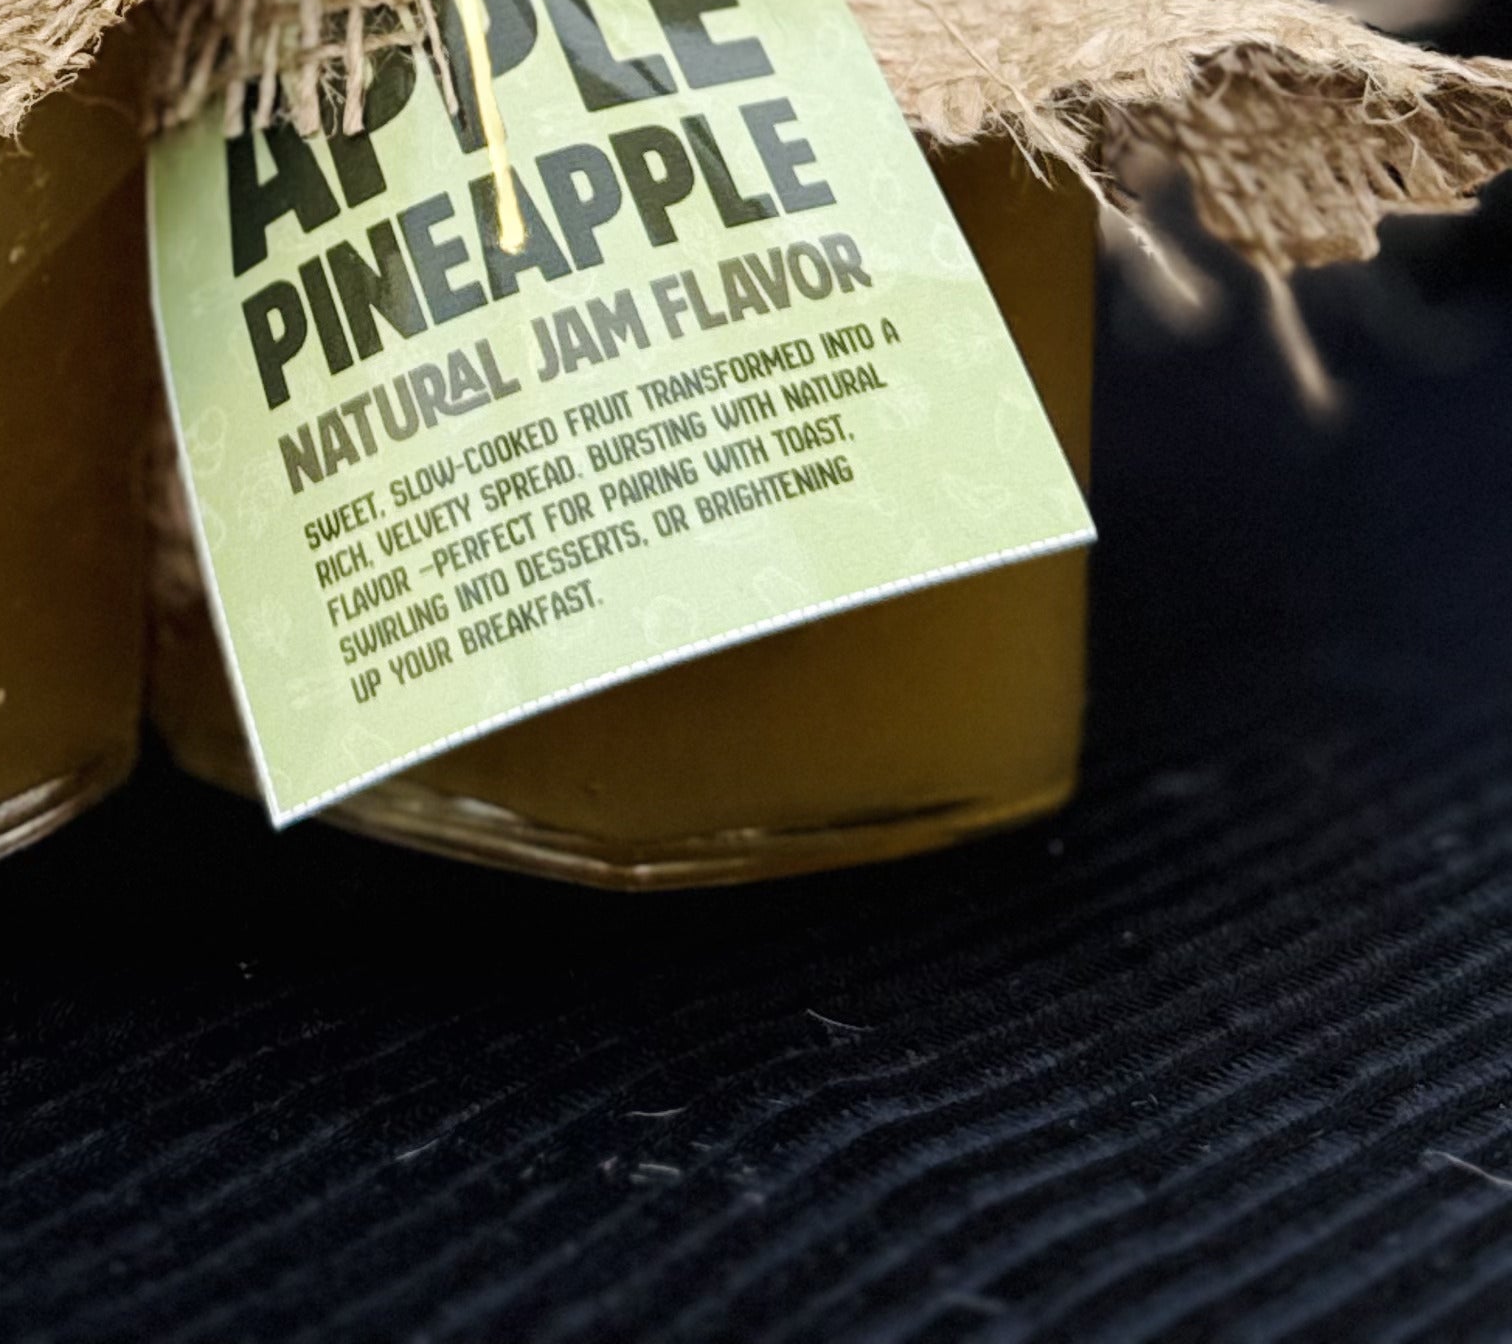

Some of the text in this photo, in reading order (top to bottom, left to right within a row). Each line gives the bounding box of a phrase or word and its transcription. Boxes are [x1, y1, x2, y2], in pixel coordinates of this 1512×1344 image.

[240, 99, 837, 412] PINEAPPLE
[277, 234, 873, 496] NATURAL JAM FLAVOR
[303, 317, 901, 551] SWEET, SLOW-COOKED FRUIT TRANSFORMED INTO A
[314, 541, 374, 590] RICH,
[376, 492, 472, 557] VELVETY
[586, 411, 708, 473] BURSTING
[711, 389, 778, 432] WITH
[780, 362, 888, 412] NATURAL
[326, 566, 412, 628] FLAVOR
[542, 491, 595, 533] FOR
[599, 457, 699, 513] PAIRING
[702, 435, 770, 477] WITH
[770, 413, 855, 457] TOAST,
[339, 454, 855, 666] SWIRLING INTO DESSERTS, OR BRIGHTENING
[350, 578, 604, 704] UP YOUR BREAKFAST.
